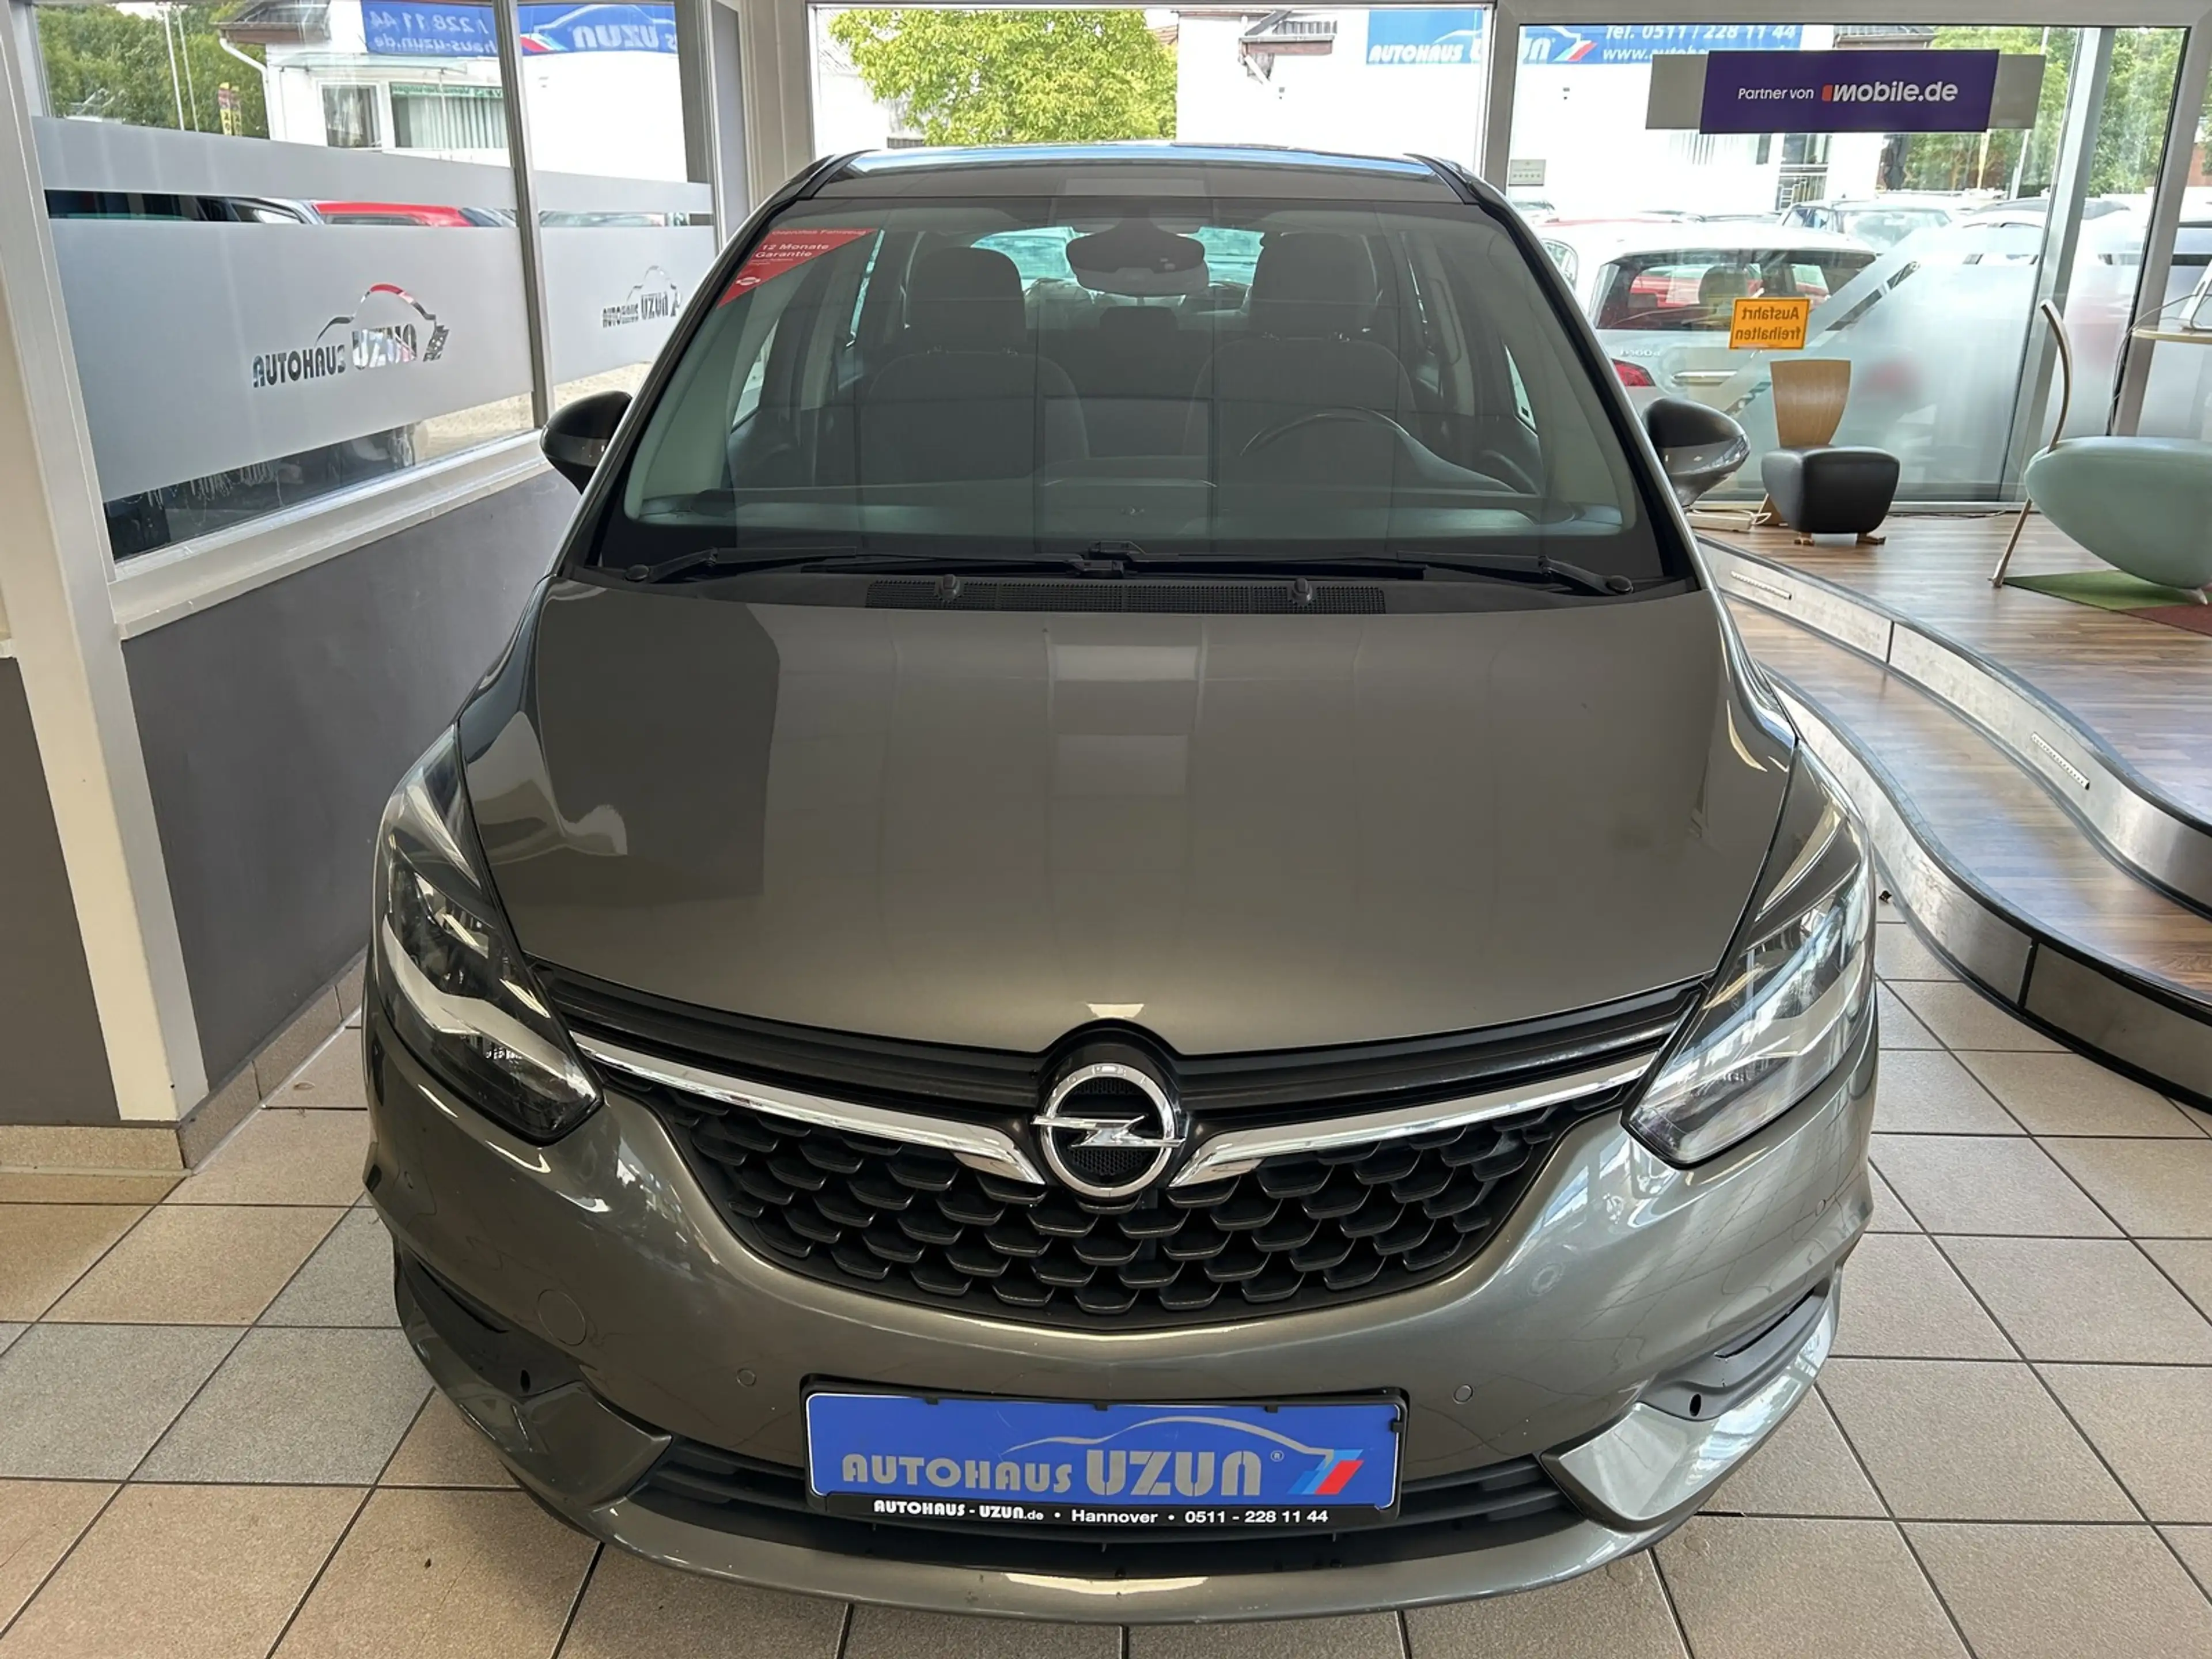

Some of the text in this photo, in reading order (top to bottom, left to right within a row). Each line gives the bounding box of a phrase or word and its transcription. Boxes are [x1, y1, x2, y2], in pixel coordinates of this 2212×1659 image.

[1368, 44, 1464, 63] AUTOHAUS
[1737, 81, 1958, 102] Partner von mobile.de
[641, 291, 668, 320] UZUN
[252, 343, 346, 388] AUTOHAUS
[842, 1453, 1072, 1494] AUTOHAUS
[873, 1500, 965, 1517] AUTOHAUS
[979, 1505, 1044, 1521] UZUN.de
[1071, 1509, 1158, 1523] Hannover
[1184, 1510, 1226, 1524] 0511
[1244, 1510, 1278, 1524] 228
[1282, 1510, 1302, 1523] 11
[1306, 1509, 1328, 1522] 44
